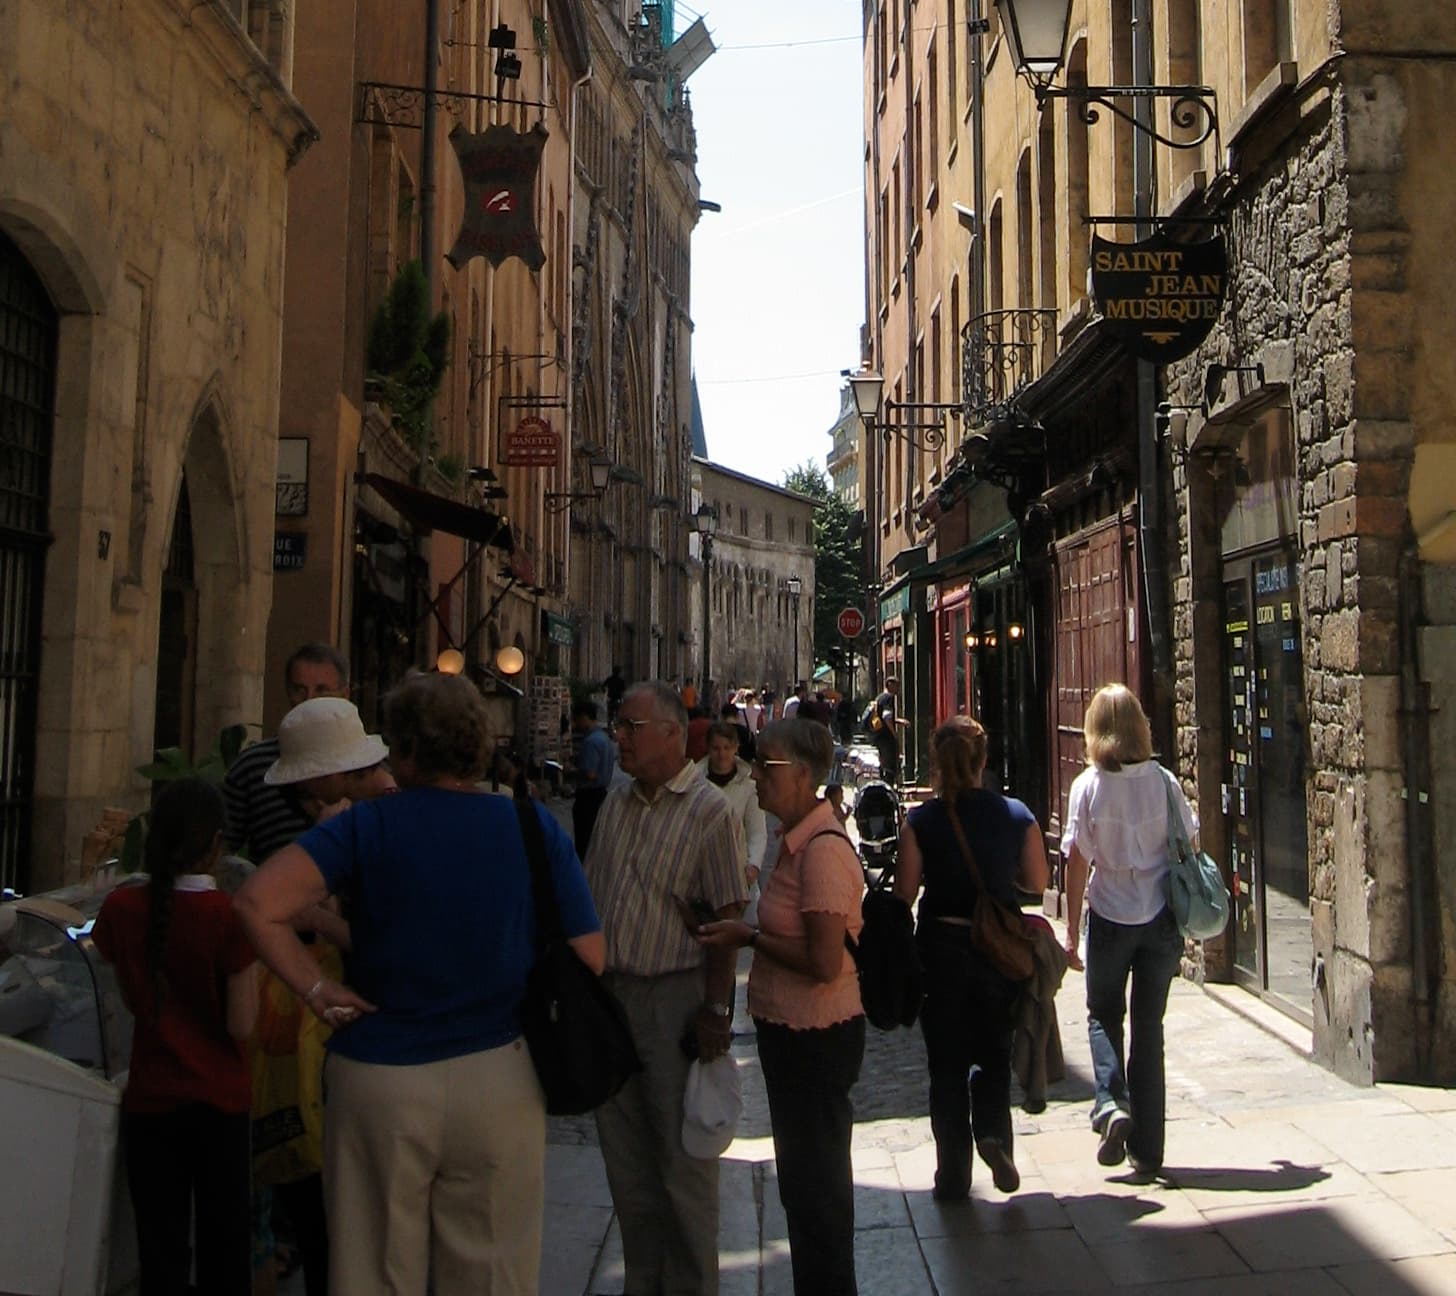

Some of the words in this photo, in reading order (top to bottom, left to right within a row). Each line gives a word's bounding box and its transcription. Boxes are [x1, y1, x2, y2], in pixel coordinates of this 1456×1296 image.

[1095, 251, 1183, 272] SAINT
[1145, 275, 1221, 296] JEAN
[1106, 298, 1218, 322] MUSIQUE
[276, 537, 292, 551] UE
[274, 554, 304, 567] ROIX
[840, 617, 861, 629] STOP
